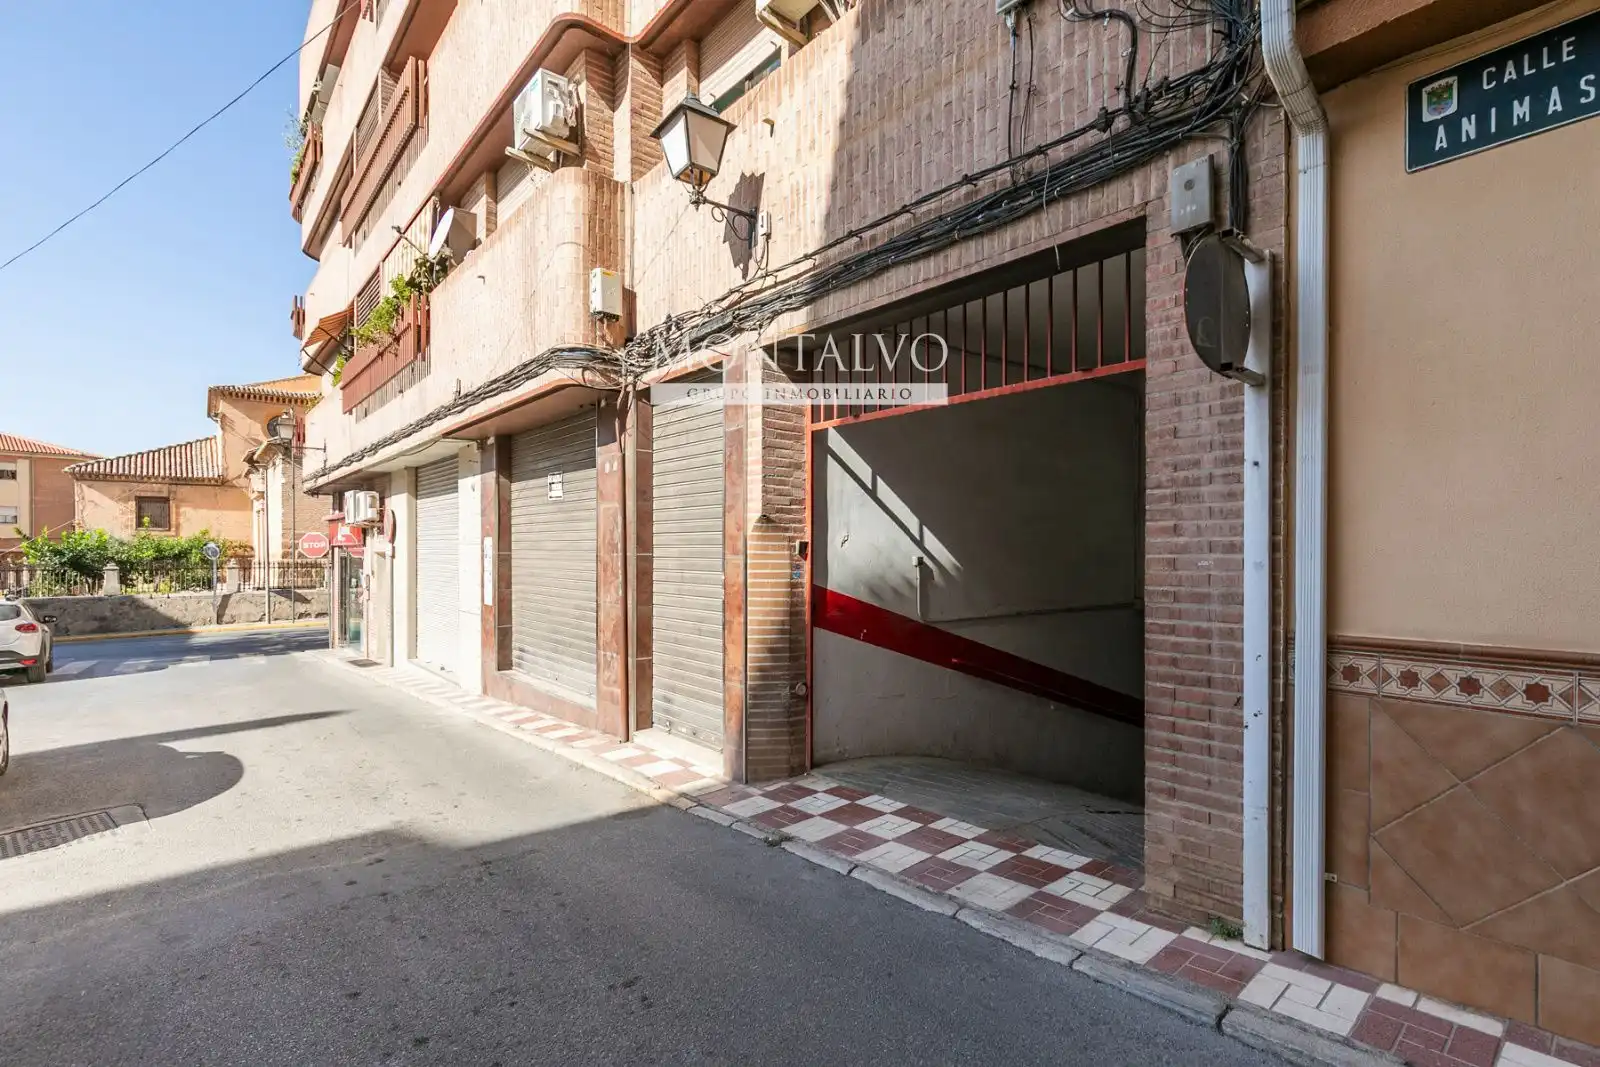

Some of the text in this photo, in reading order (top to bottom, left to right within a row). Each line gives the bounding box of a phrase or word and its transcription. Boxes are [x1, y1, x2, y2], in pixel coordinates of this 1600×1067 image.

[1482, 36, 1576, 90] CALLE
[1434, 74, 1596, 151] ANIMAS
[303, 541, 326, 549] STOP
